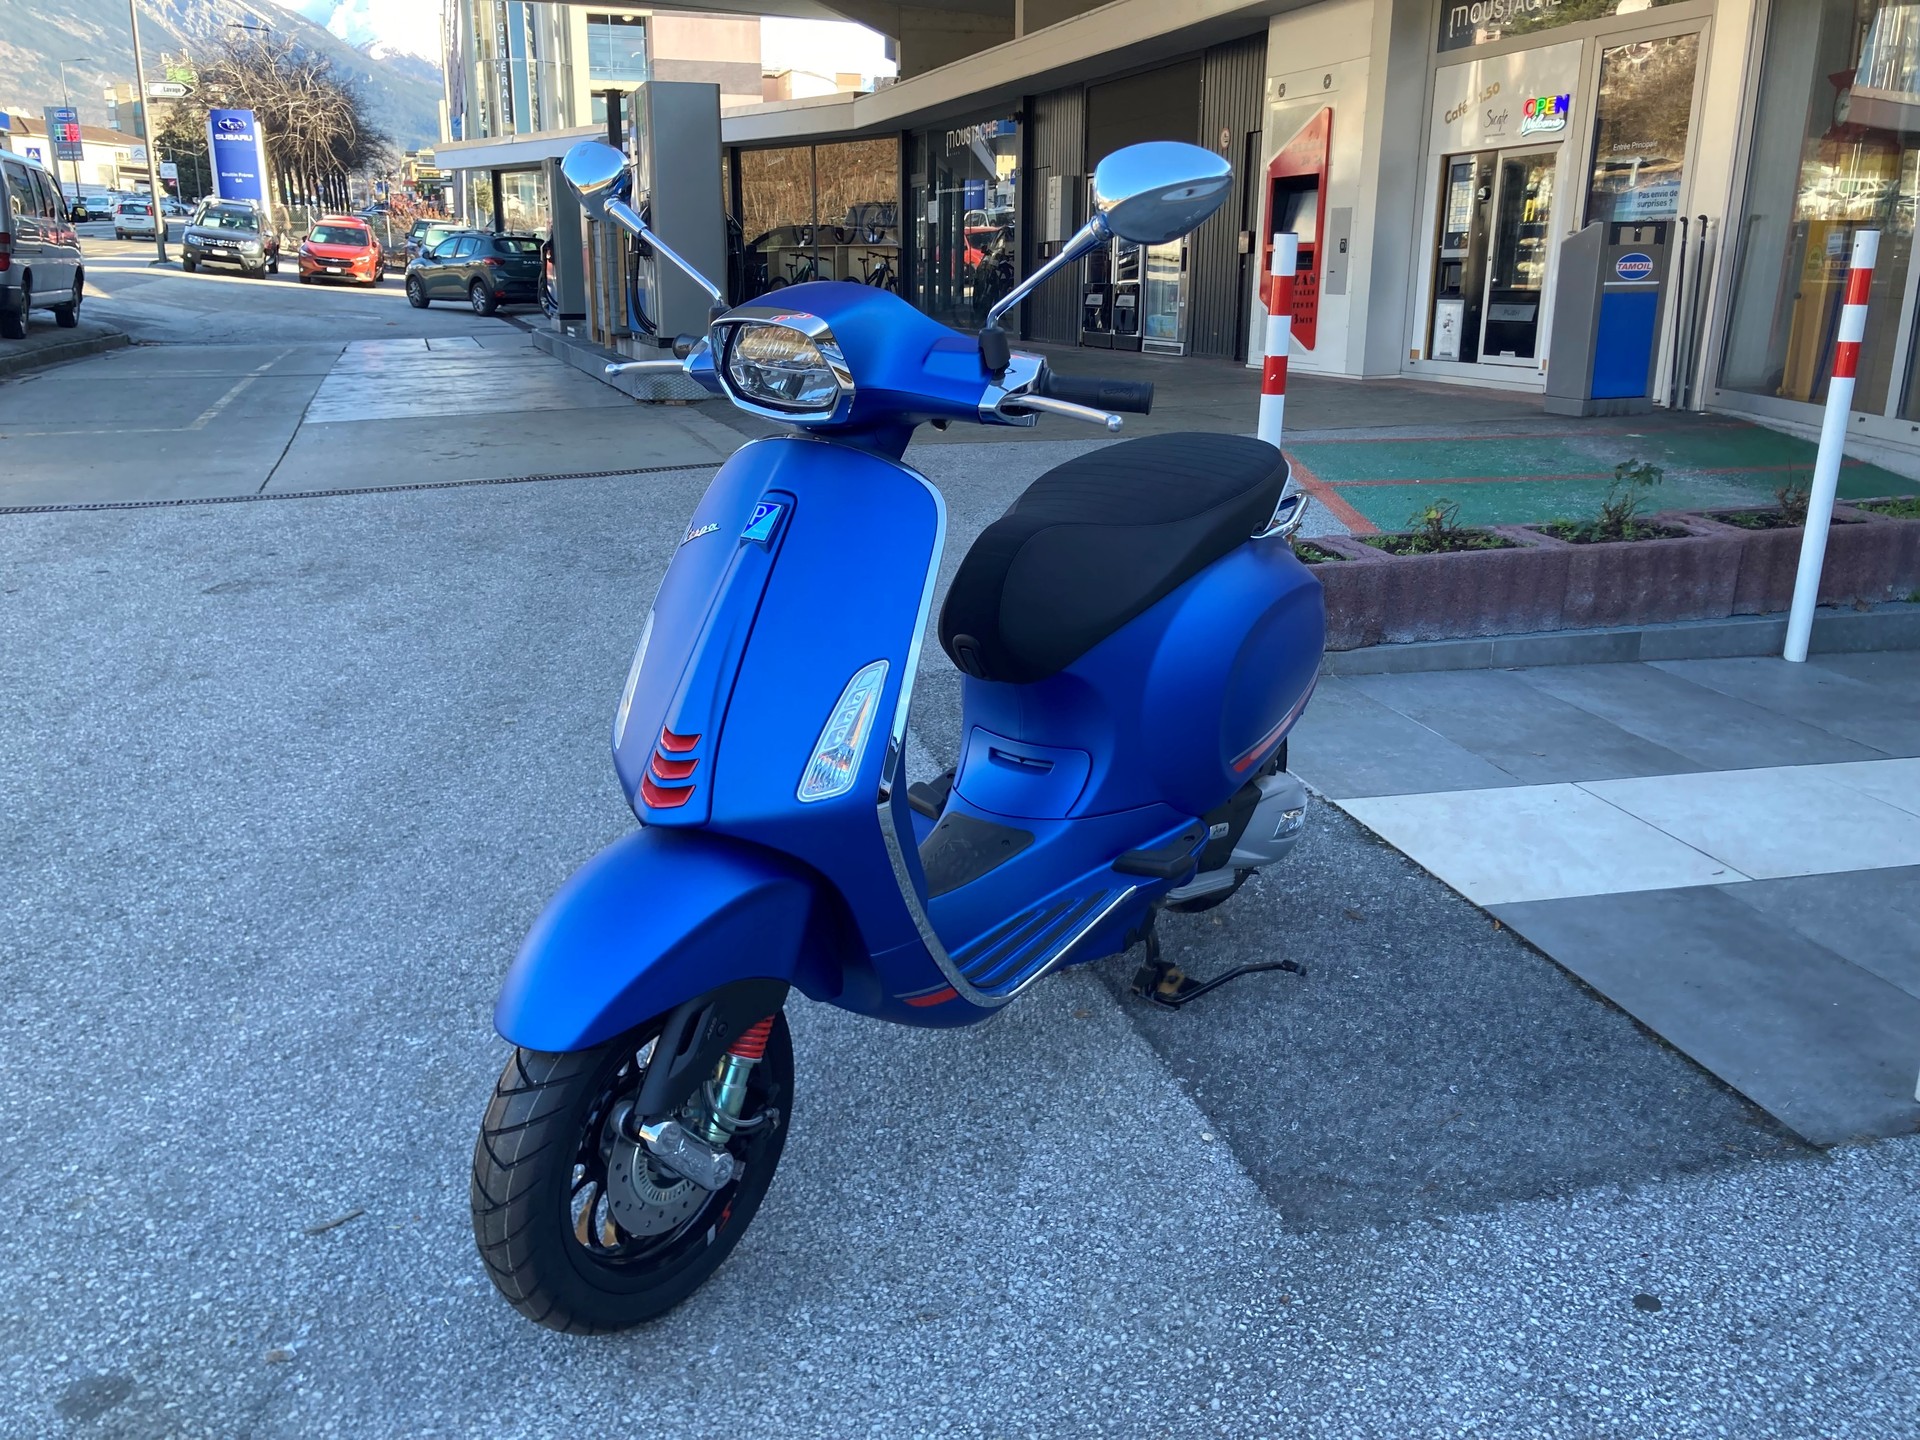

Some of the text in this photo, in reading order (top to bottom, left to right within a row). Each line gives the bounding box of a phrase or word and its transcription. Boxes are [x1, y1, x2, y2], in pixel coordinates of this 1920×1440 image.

[1444, 99, 1468, 124] Café
[1523, 94, 1570, 118] OPEN
[1521, 114, 1565, 137] Welcome
[215, 133, 253, 141] SUBARU
[946, 120, 998, 157] MOUSTACHE
[1612, 143, 1631, 151] Entrée
[1638, 189, 1678, 199] Pas envie de
[1637, 199, 1668, 208] surprises
[1617, 263, 1652, 271] TAMOIL
[1294, 274, 1316, 286] ZAS
[749, 505, 767, 525] P
